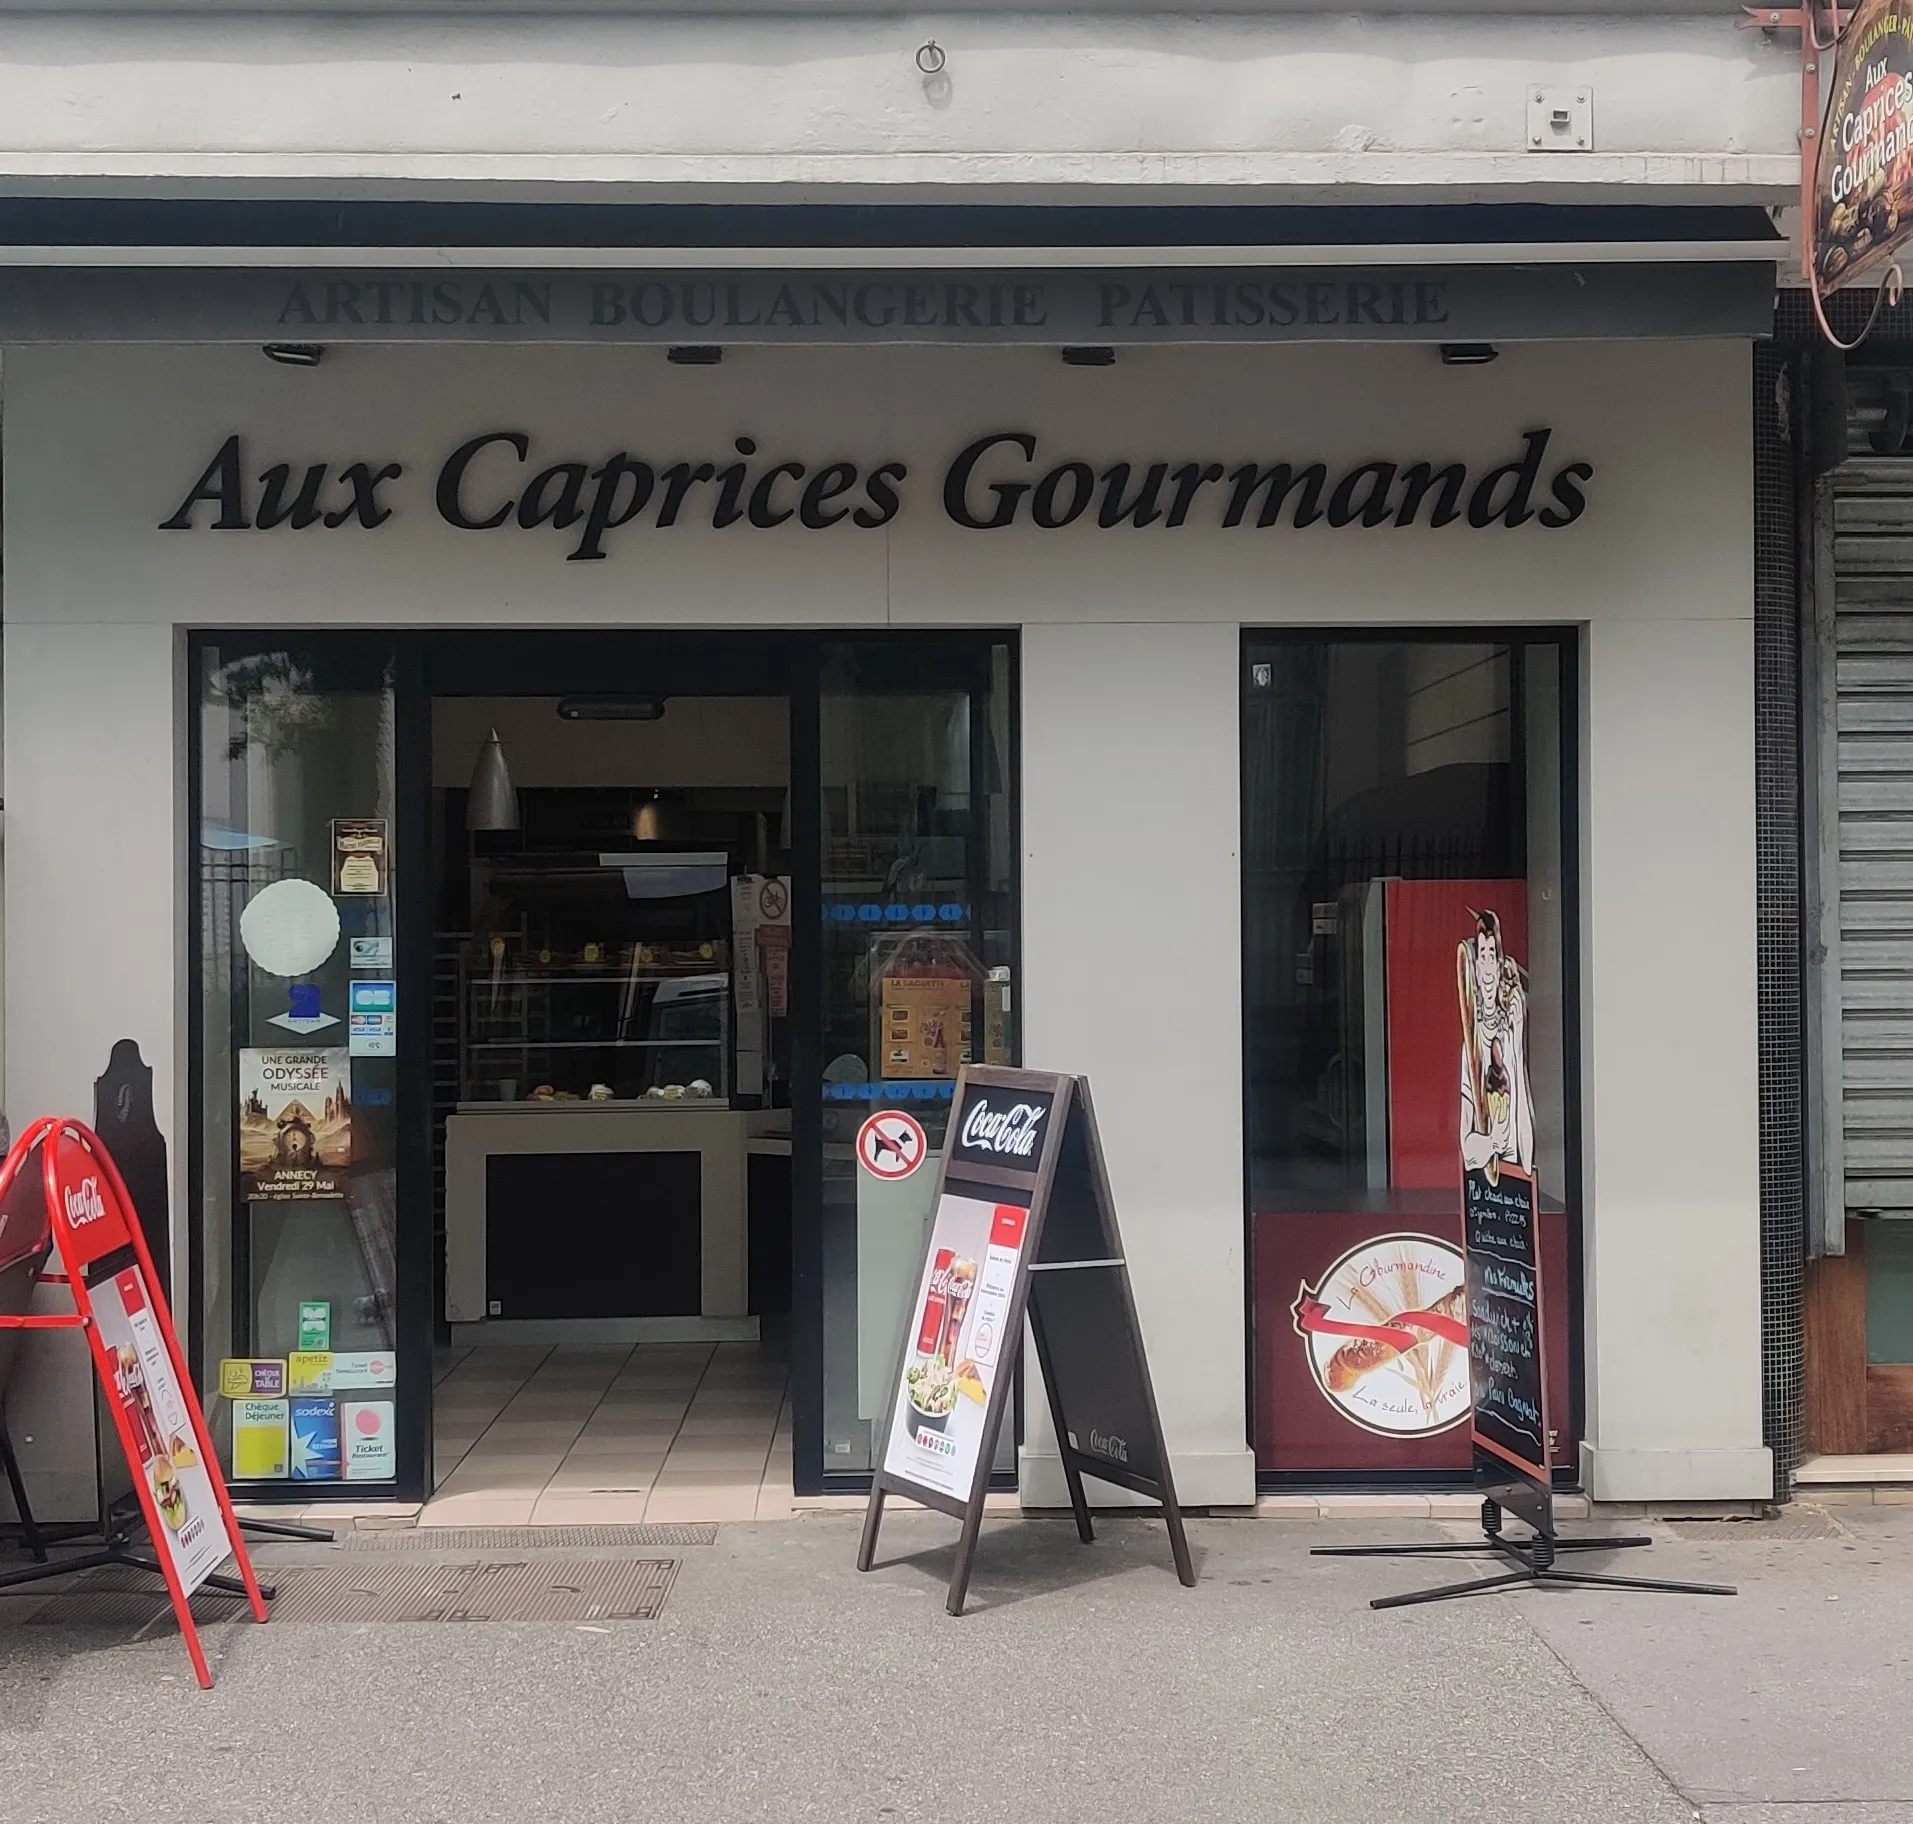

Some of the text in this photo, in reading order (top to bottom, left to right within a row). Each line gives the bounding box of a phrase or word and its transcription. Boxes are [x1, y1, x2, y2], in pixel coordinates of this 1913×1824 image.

[1855, 15, 1898, 71] BOULANGER
[1865, 57, 1888, 93] Aux
[1842, 71, 1913, 152] Caprices
[276, 281, 1450, 328] ARTISAN BOULANGERIE PATISSERIE
[159, 428, 1594, 561] Aux Caprices Gourmands
[262, 1056, 327, 1065] UNE GRANDE
[263, 1065, 328, 1080] ODYSSÉE
[271, 1083, 320, 1091] MUSICALE
[274, 1170, 318, 1180] ANNECY
[257, 1180, 334, 1191] Vendredi 29 Mai
[1336, 1259, 1446, 1310] La Gourmandine
[296, 1355, 328, 1364] apetiz
[255, 1379, 280, 1388] TABLE
[1352, 1385, 1377, 1406] La
[1382, 1397, 1418, 1414] seule,
[245, 1402, 280, 1413] Chèque
[245, 1411, 285, 1421] Déjeuner
[356, 1445, 384, 1453] Ticket
